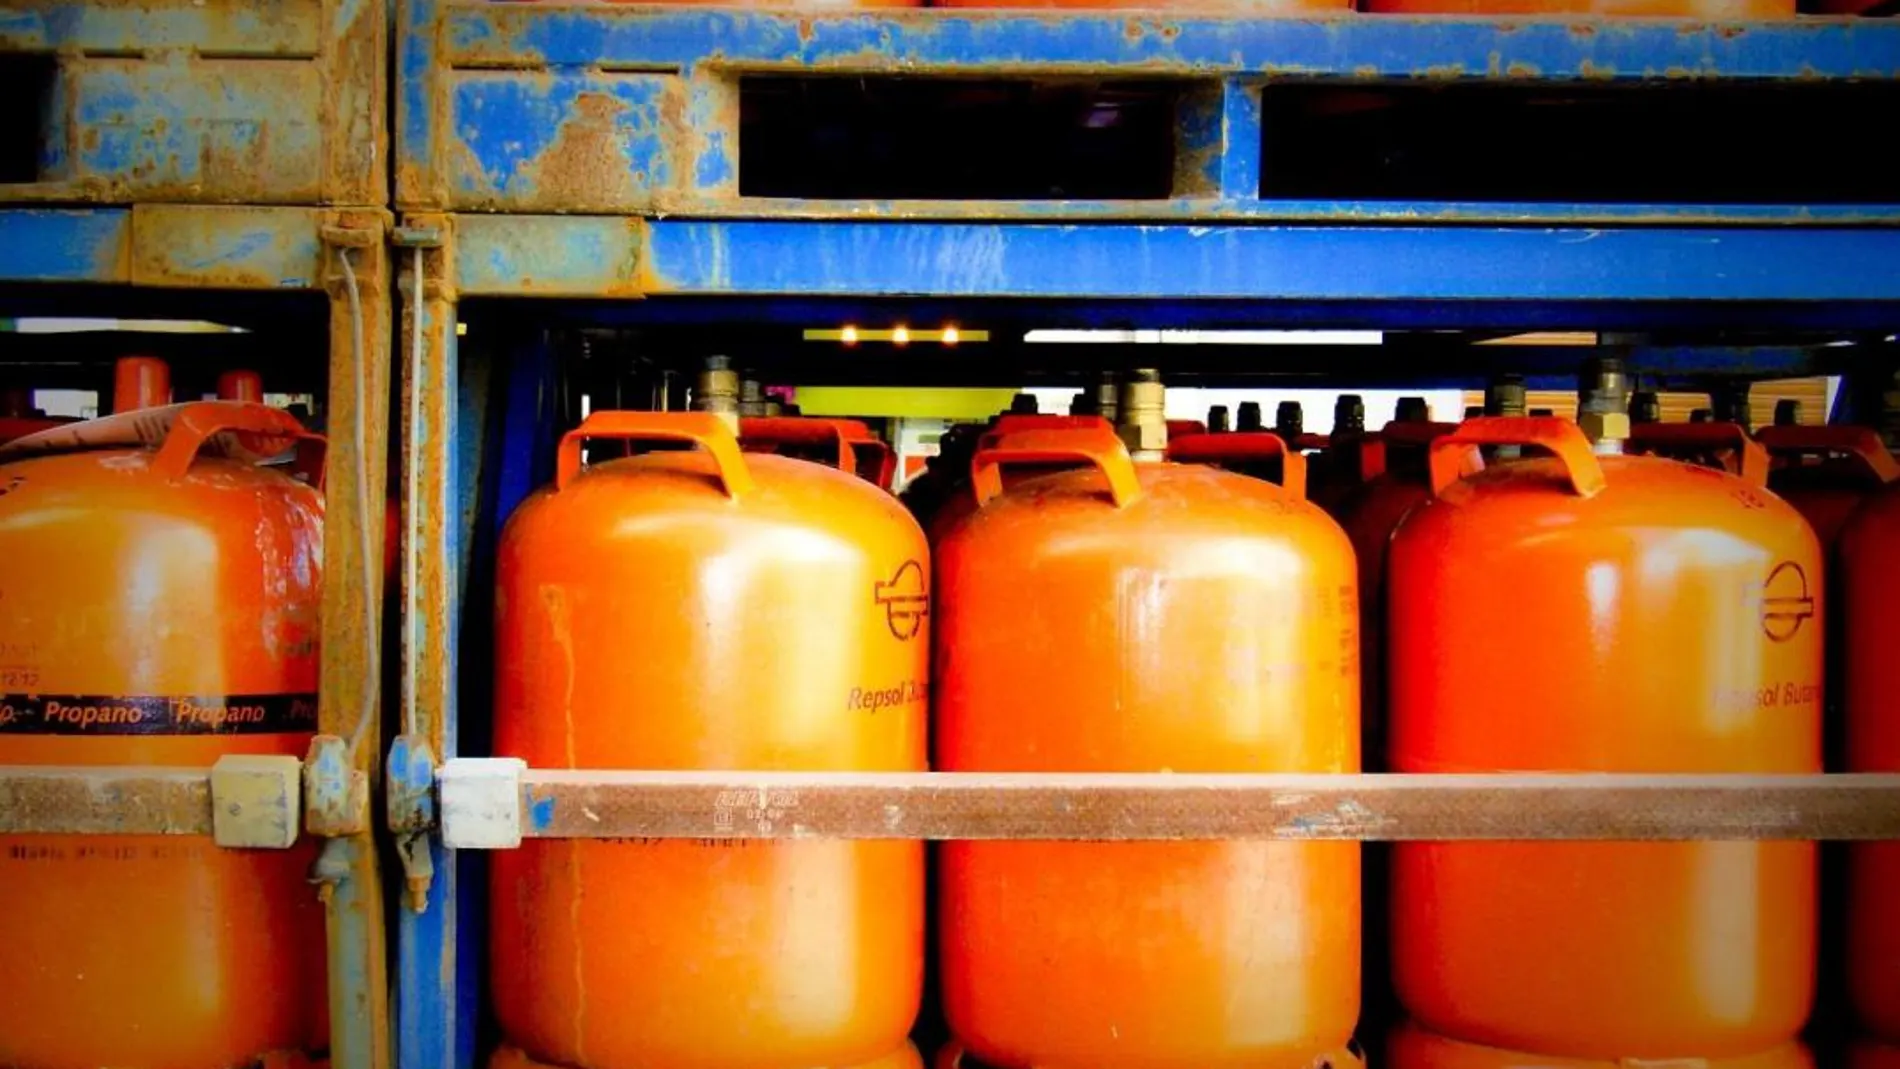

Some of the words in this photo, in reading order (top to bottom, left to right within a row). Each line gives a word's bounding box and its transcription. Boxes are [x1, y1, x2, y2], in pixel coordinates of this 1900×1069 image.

[848, 681, 905, 716] Repsol
[44, 701, 143, 730] Propano
[176, 700, 265, 730] Propano
